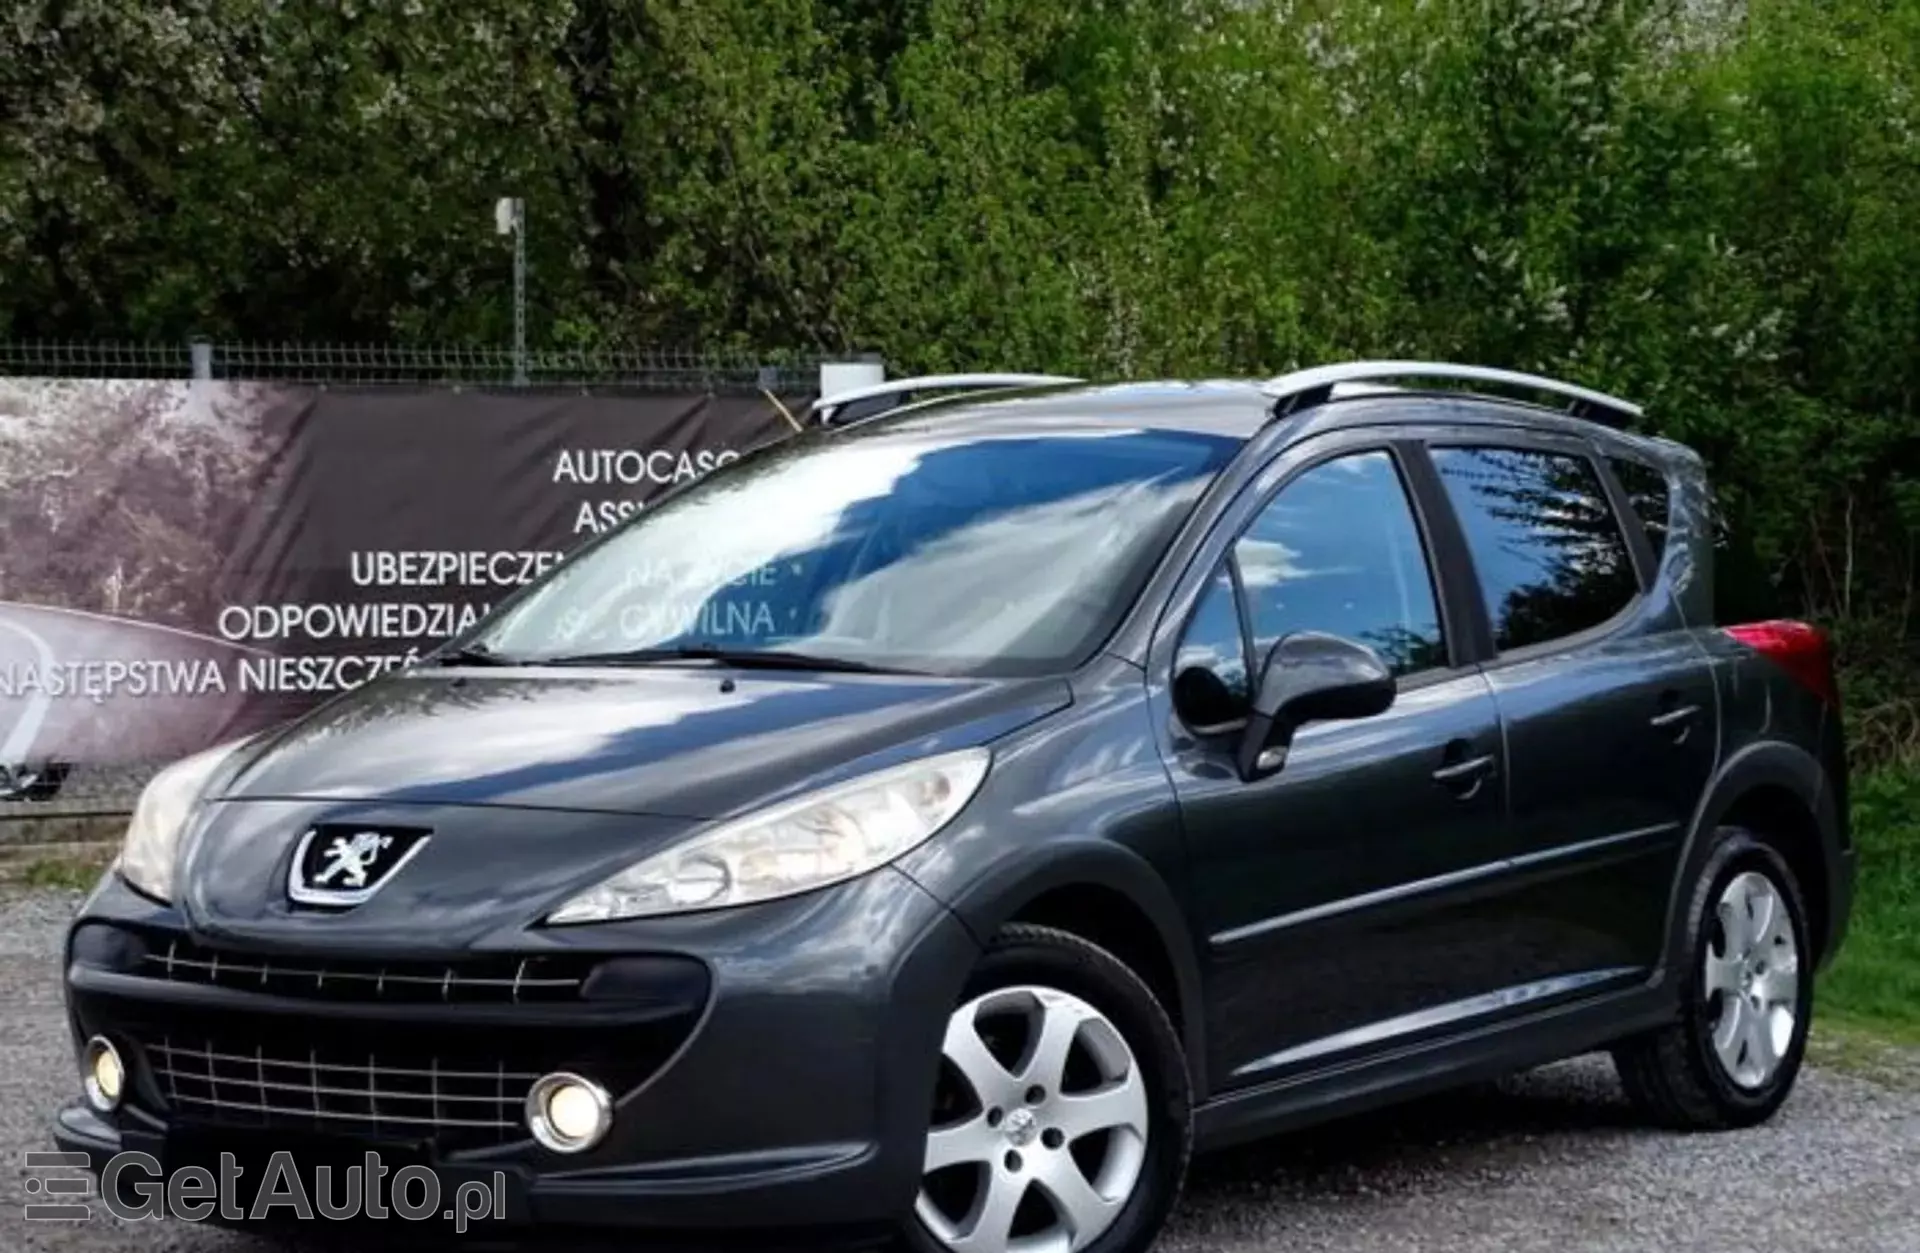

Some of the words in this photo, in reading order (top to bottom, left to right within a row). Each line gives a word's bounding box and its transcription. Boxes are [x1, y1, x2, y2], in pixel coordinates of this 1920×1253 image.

[573, 500, 645, 534] ASS
[351, 551, 565, 586] UBEZPIECZE
[218, 603, 491, 639] ODPOWIEDZIA
